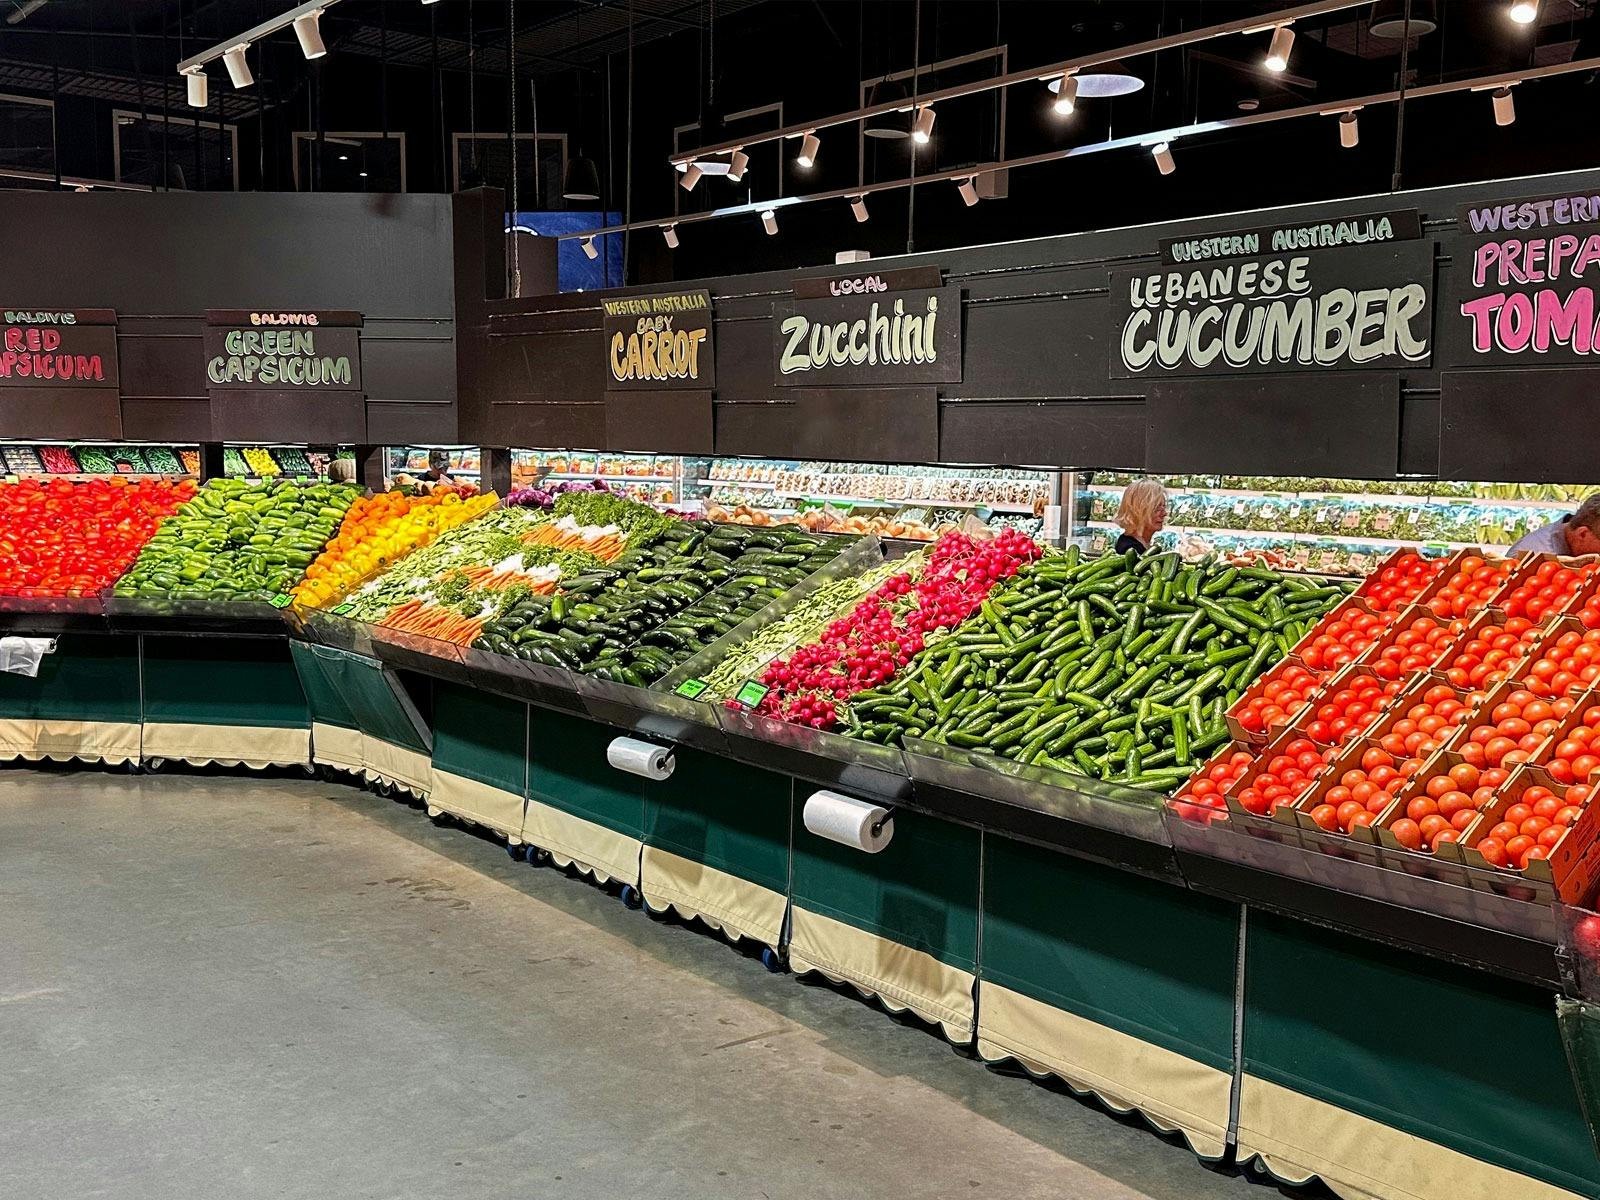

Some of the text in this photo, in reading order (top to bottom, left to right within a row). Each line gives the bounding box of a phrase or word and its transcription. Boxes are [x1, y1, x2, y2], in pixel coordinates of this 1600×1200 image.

[1172, 216, 1394, 262] WESTERN AUSTRALIA
[829, 275, 888, 297] LOCAL
[1130, 257, 1312, 308] LEBANESE
[4, 311, 77, 325] BALDIVIS
[250, 312, 319, 326] BALDIVIS
[605, 294, 707, 316] WESTERN AUSTRALIA
[637, 315, 674, 335] BABY
[780, 296, 938, 375] Zucchini
[1121, 283, 1431, 372] CUCUMBER
[1461, 287, 1600, 355] TOM
[4, 327, 61, 353] RED
[225, 330, 316, 356] GREEN
[611, 328, 707, 382] CARROT
[0, 351, 105, 382] PSICUM
[207, 355, 352, 386] CAPSICUM
